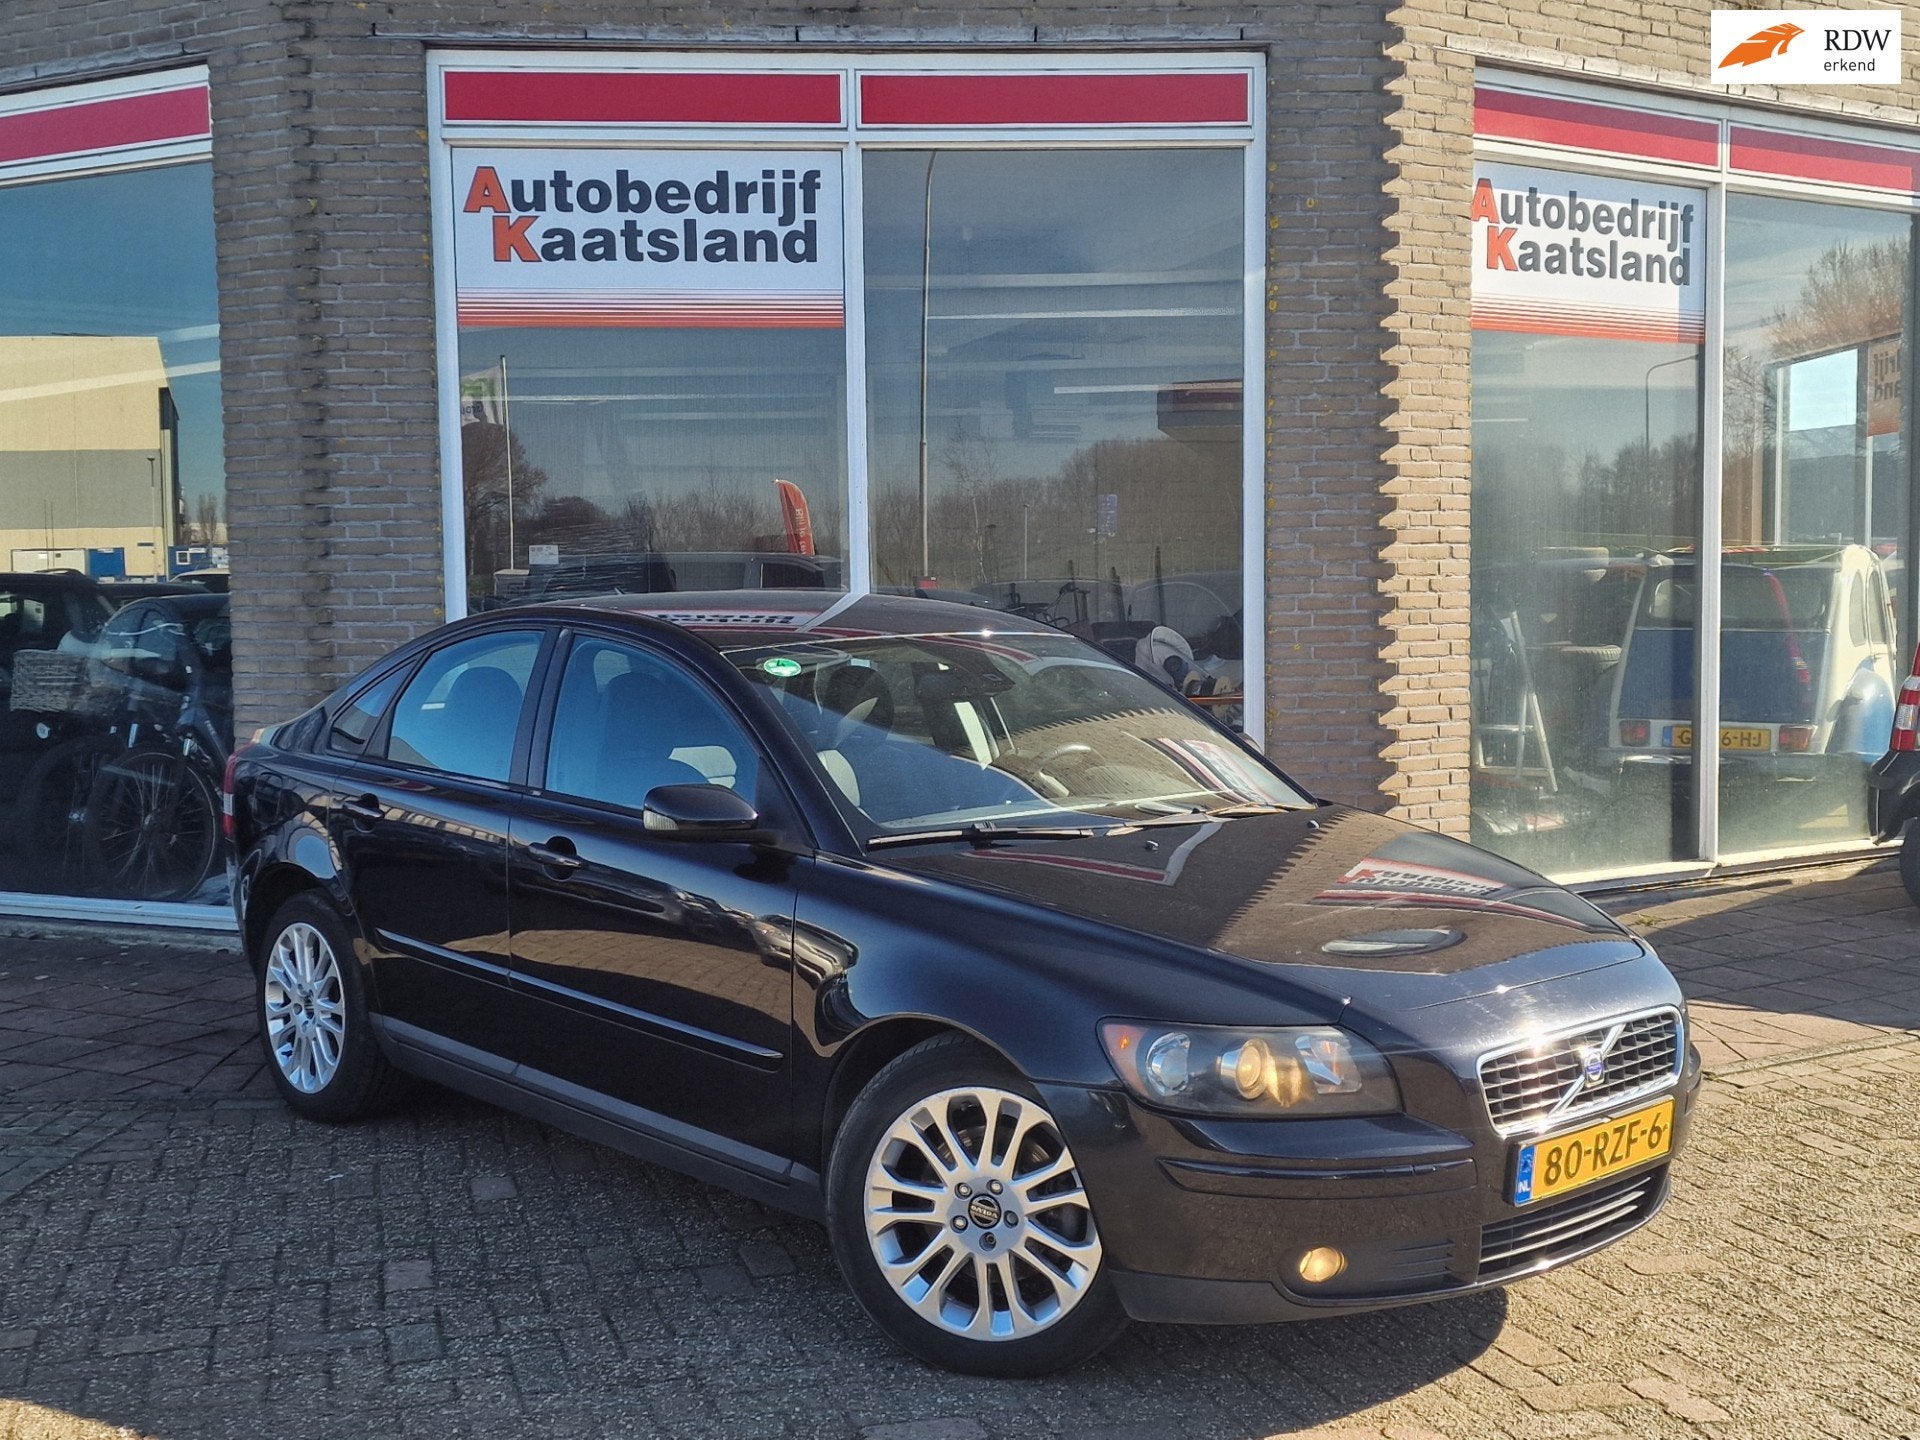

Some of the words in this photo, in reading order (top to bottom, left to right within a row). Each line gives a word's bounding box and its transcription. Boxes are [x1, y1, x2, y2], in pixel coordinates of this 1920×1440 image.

[463, 166, 821, 226] Autobedrijf
[1470, 178, 1694, 253] Autobedrijf
[492, 215, 818, 263] Kaatsland
[1486, 226, 1691, 286] Kaatsland
[1544, 1112, 1663, 1186] 80-RZF-6
[1517, 1179, 1531, 1191] NL
